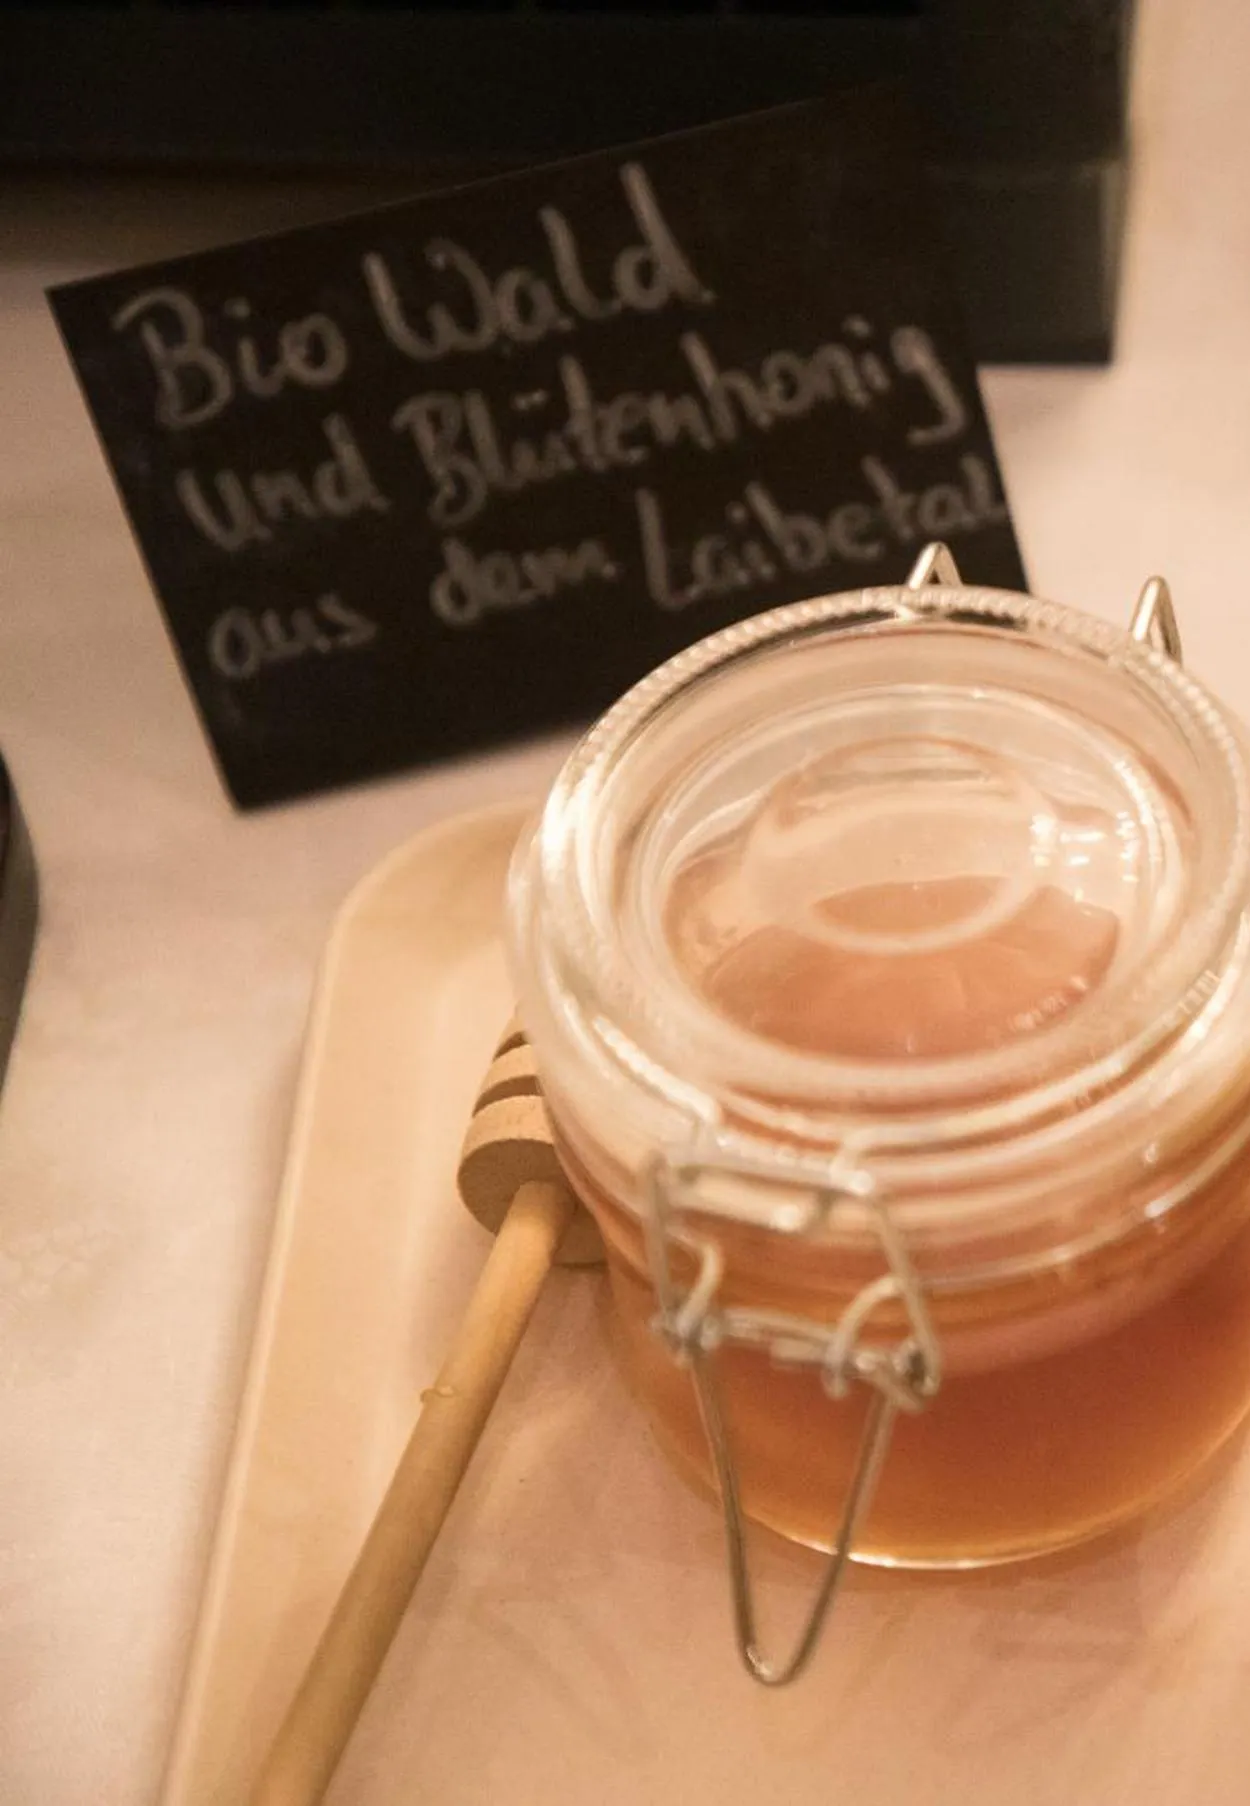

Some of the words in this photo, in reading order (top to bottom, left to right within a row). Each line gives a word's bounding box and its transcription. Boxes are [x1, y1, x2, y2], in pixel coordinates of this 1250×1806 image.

[112, 287, 348, 430] Bio
[361, 160, 715, 360] Wald
[391, 314, 966, 526] Blütenhonig
[208, 594, 378, 678] aus
